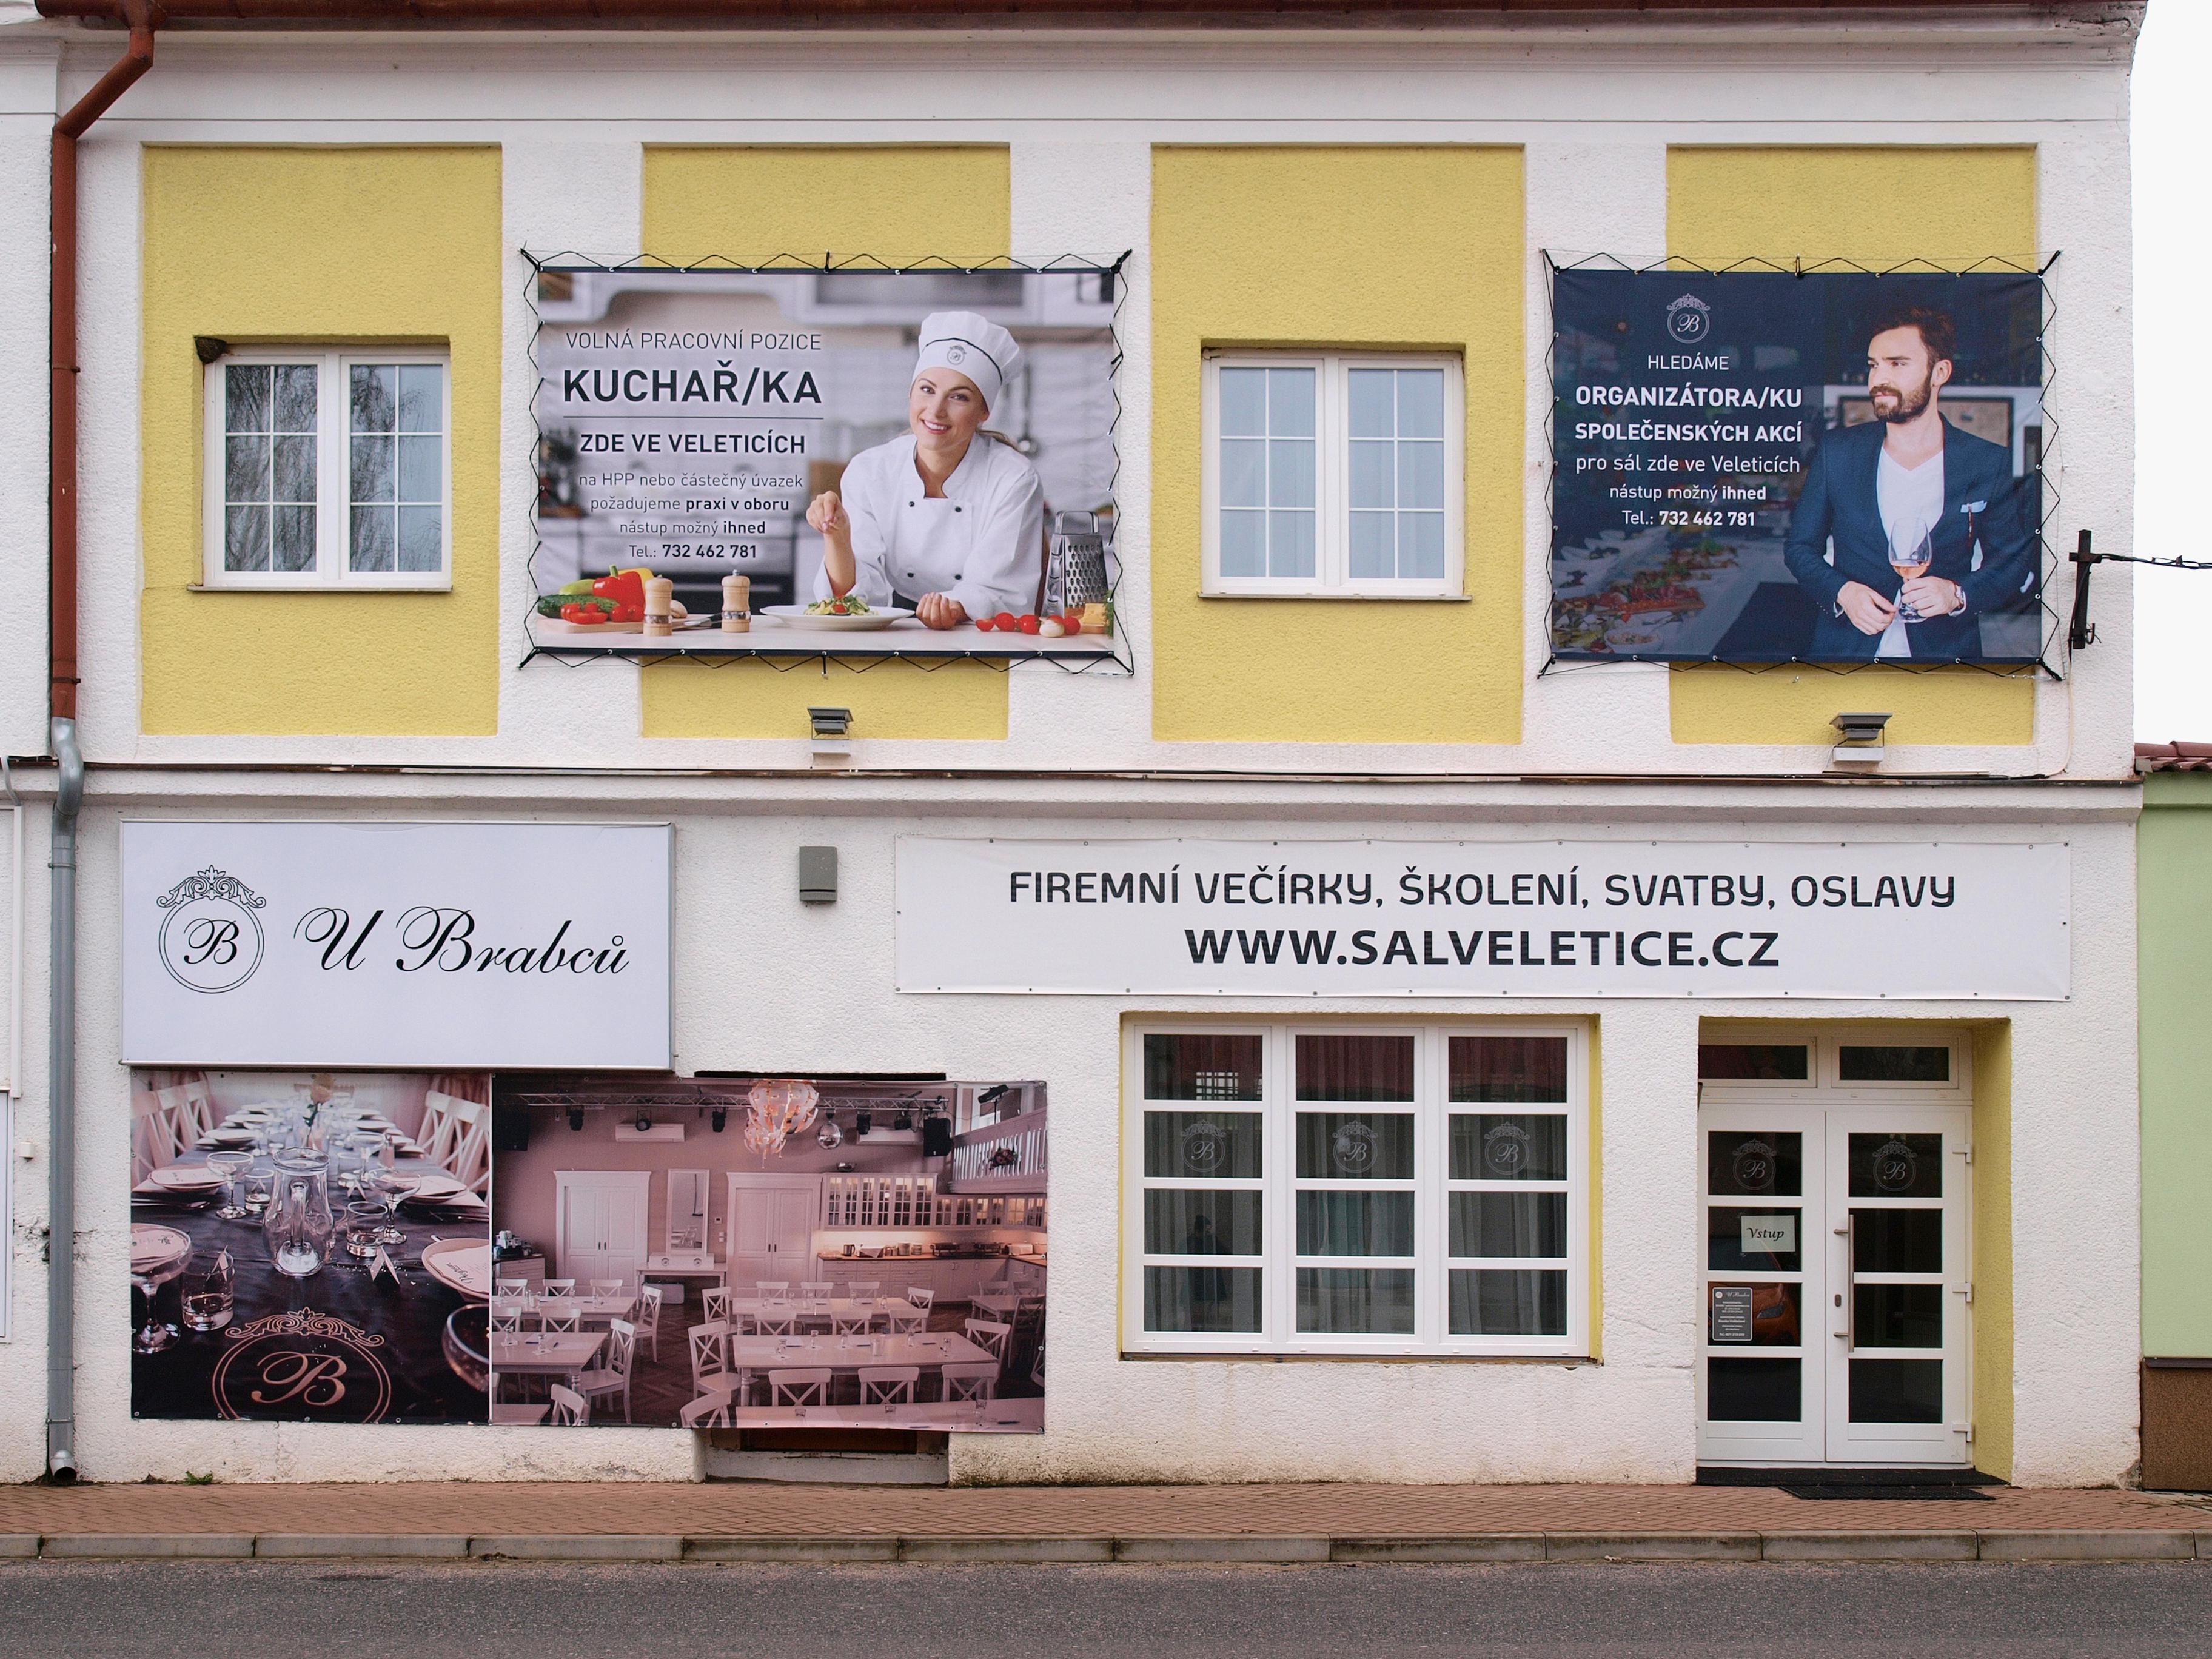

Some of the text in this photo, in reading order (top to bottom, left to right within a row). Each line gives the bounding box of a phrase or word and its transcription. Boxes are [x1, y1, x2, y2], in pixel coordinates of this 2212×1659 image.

[1677, 313, 1700, 332] B
[566, 329, 822, 350] VOLNÁ PRACOVNÍ POZICE
[1647, 352, 1729, 370] HLEDÁME
[563, 360, 822, 405] KUCHAŘ/KA
[1575, 382, 1802, 409] ORGANIZÁTORA/KU
[1575, 419, 1802, 443] SPOLEČENSKÝCH AKCÍ
[580, 430, 806, 454] ZDE VE VELETICÍCH
[1576, 454, 1800, 474] pro sál zde ve Veleticích
[580, 472, 803, 490] na HPP nebo částečný úvazek
[1610, 484, 1766, 503] nástup možný ihned
[591, 497, 789, 514] požadujeme praxi v oboru
[1622, 510, 1755, 526] Tel.: 732 462 781
[620, 520, 766, 537] nástup možný ihned
[629, 544, 757, 558] Tel.: 732 462 781
[1010, 863, 1956, 910] FIREMNÍ VEČÍRKY, ŠKOLENÍ, SVATBY, OSLAVY
[183, 917, 239, 965] B
[293, 905, 630, 974] U Brabců
[1184, 929, 1780, 966] WWW.SALVELETICE.CZ
[1191, 1141, 1215, 1161] B
[1344, 1141, 1367, 1161] B
[1495, 1143, 1519, 1163] B
[1743, 1160, 1767, 1179] B
[1883, 1161, 1906, 1181] B
[1746, 1227, 1785, 1242] Vstup
[251, 1351, 348, 1406] B
